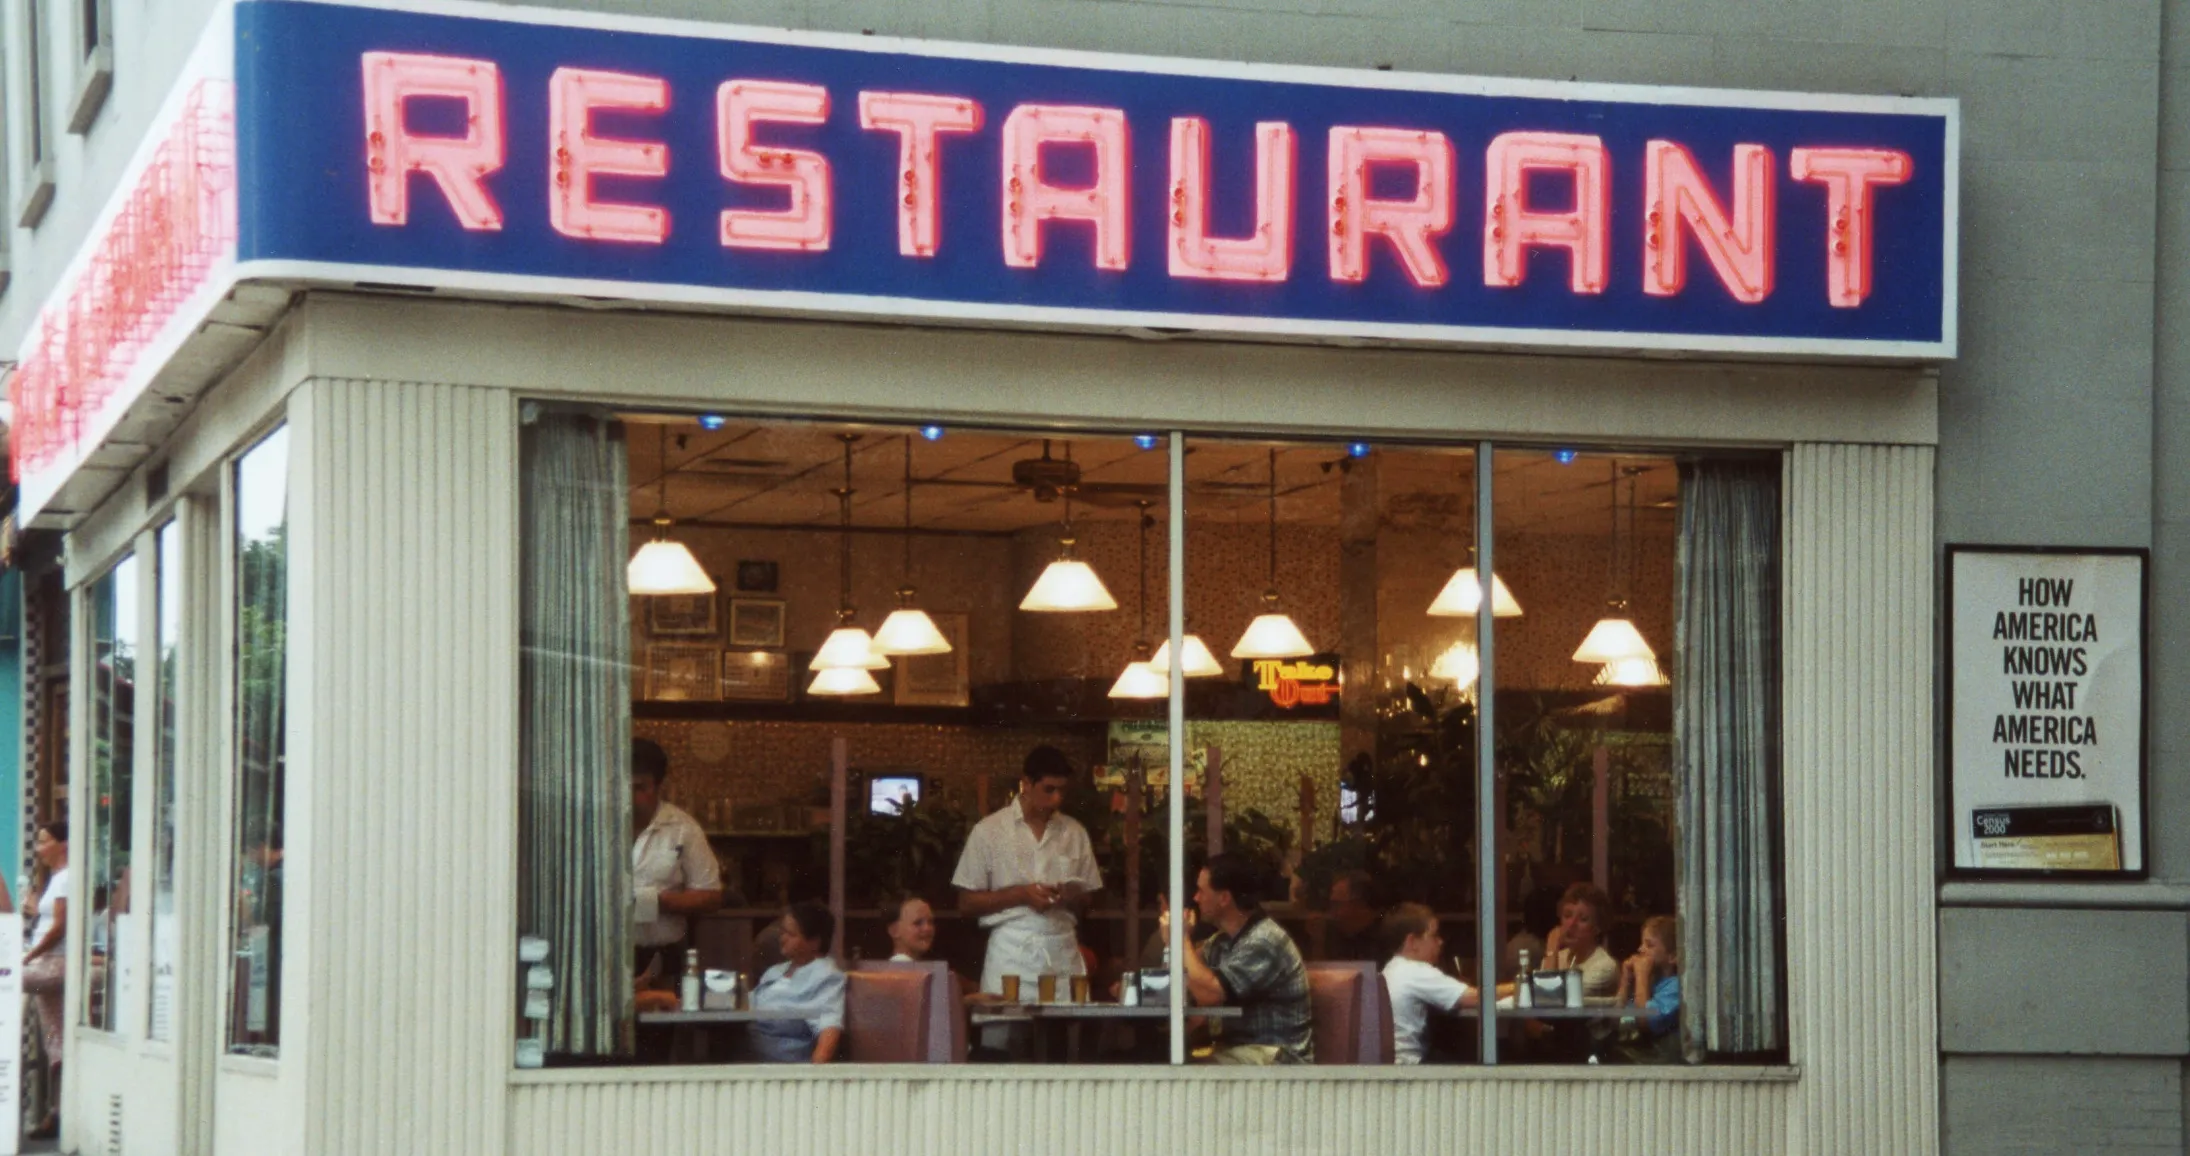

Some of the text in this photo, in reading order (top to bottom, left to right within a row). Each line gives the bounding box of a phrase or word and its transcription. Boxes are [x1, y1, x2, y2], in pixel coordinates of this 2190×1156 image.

[361, 51, 1912, 308] RESTAURANT
[2018, 577, 2073, 607] HOW
[1992, 611, 2098, 642] AMERICA
[1253, 660, 1334, 690] Take
[2003, 646, 2087, 676] KNOWS
[2012, 680, 2078, 710] WHAT
[1992, 714, 2098, 745] AMERICA
[2004, 749, 2086, 779] NEEDS.
[1976, 815, 2011, 826] Census
[1983, 824, 2006, 835] 2000
